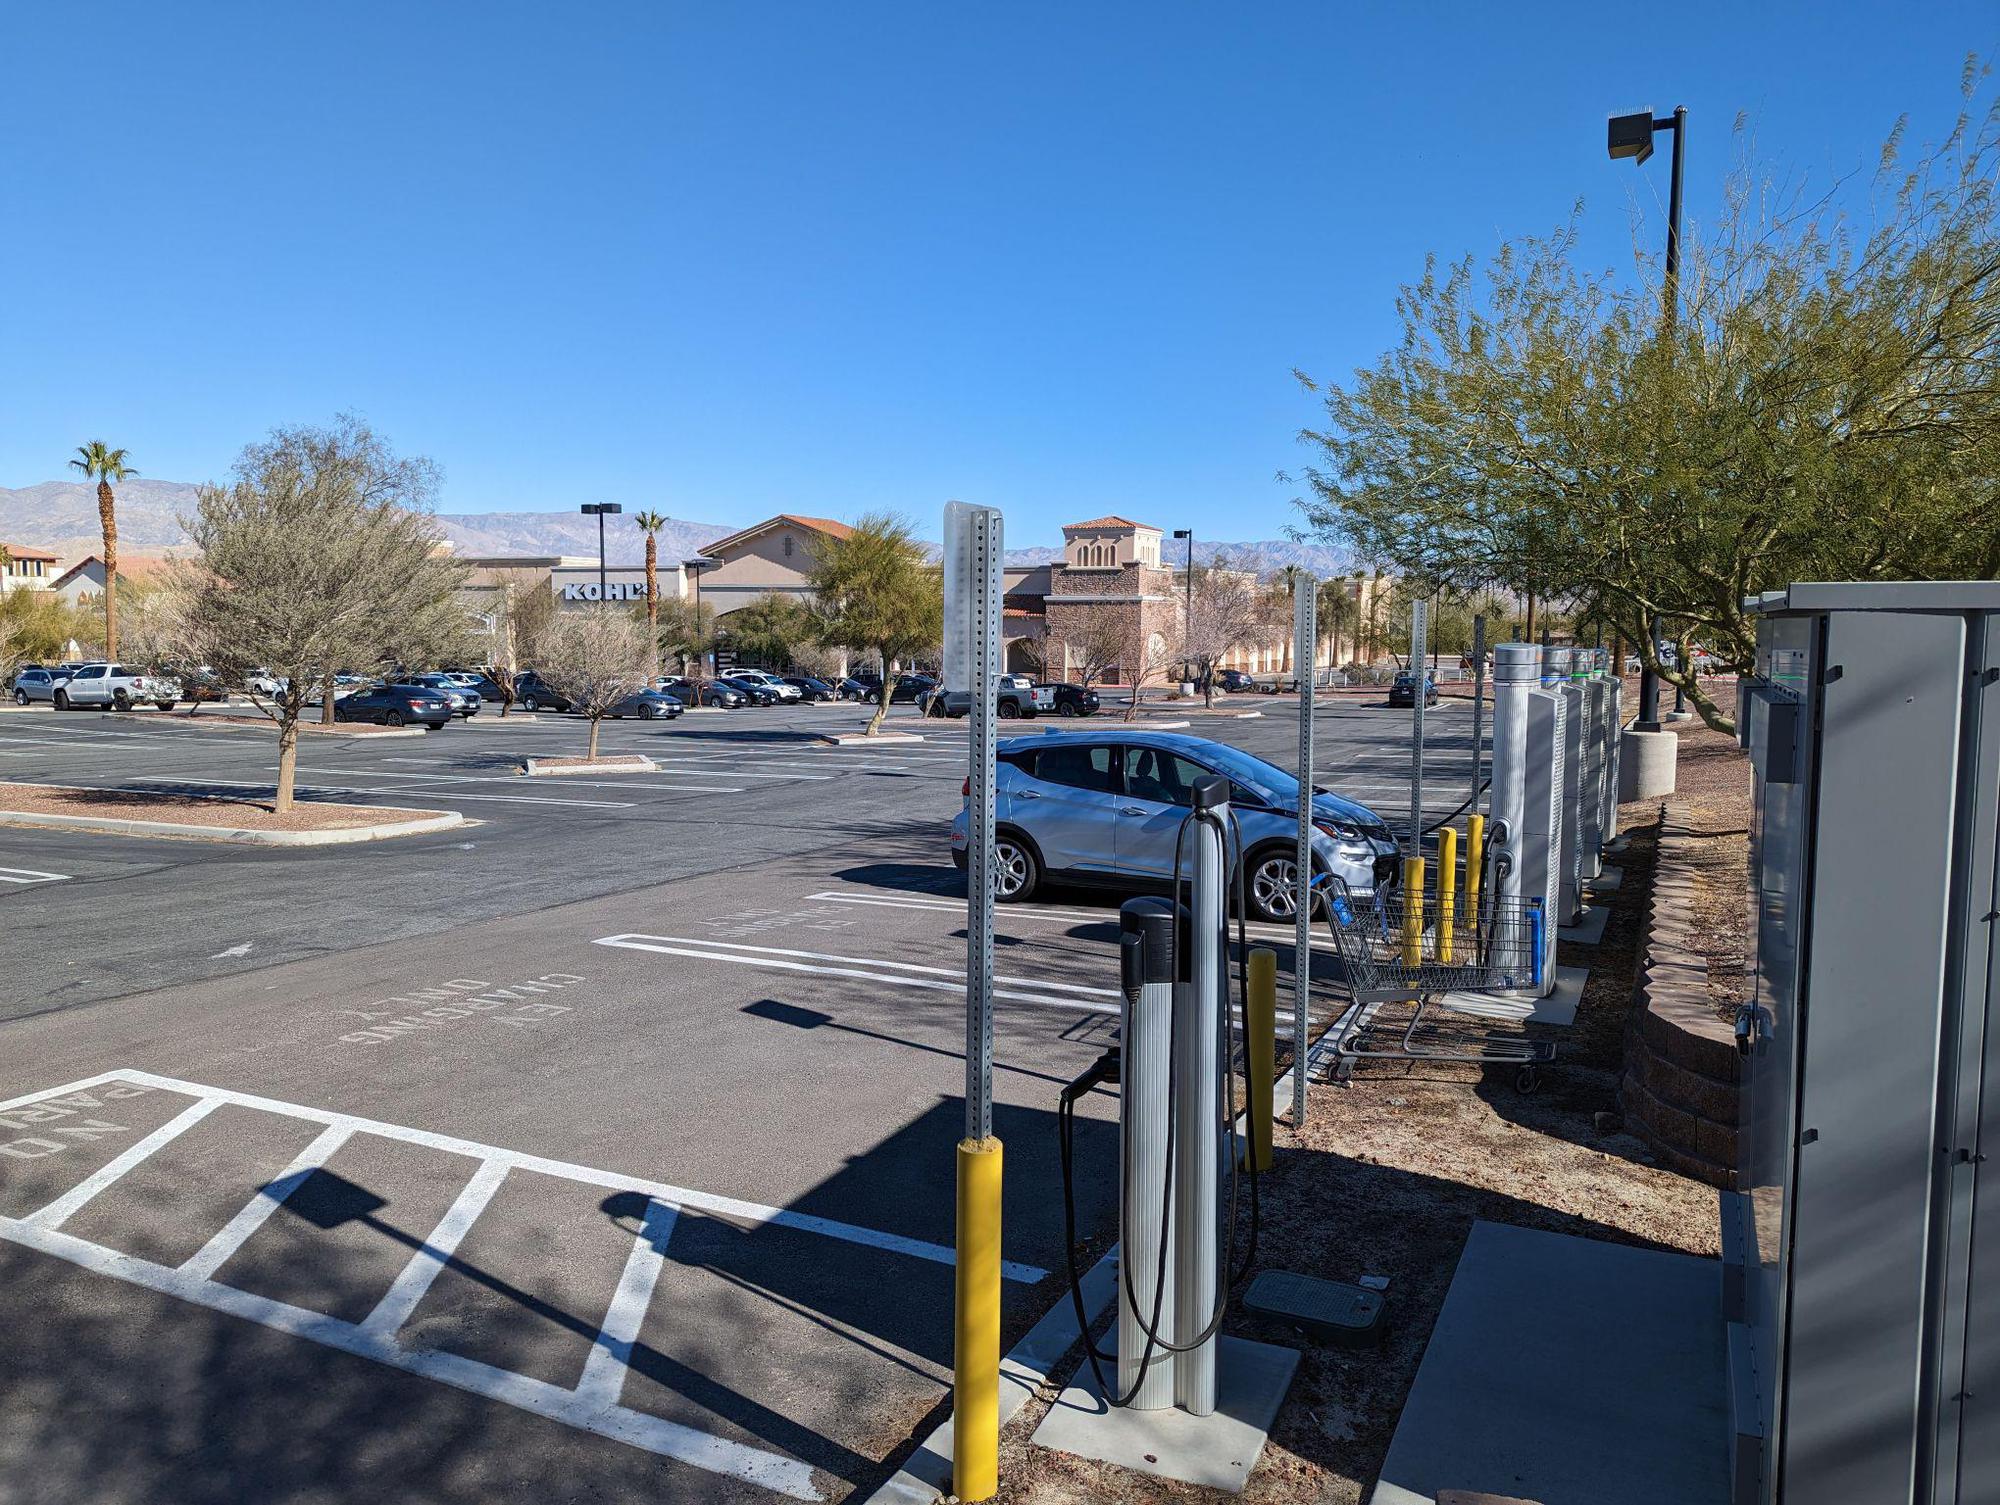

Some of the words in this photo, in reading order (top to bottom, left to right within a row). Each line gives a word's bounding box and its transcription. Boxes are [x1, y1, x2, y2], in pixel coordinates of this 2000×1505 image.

[336, 979, 491, 1022] ONLY
[337, 974, 587, 1044] CHARGING
[491, 1003, 574, 1027] EV
[0, 1081, 157, 1130] PAR
[0, 1118, 131, 1159] NO
